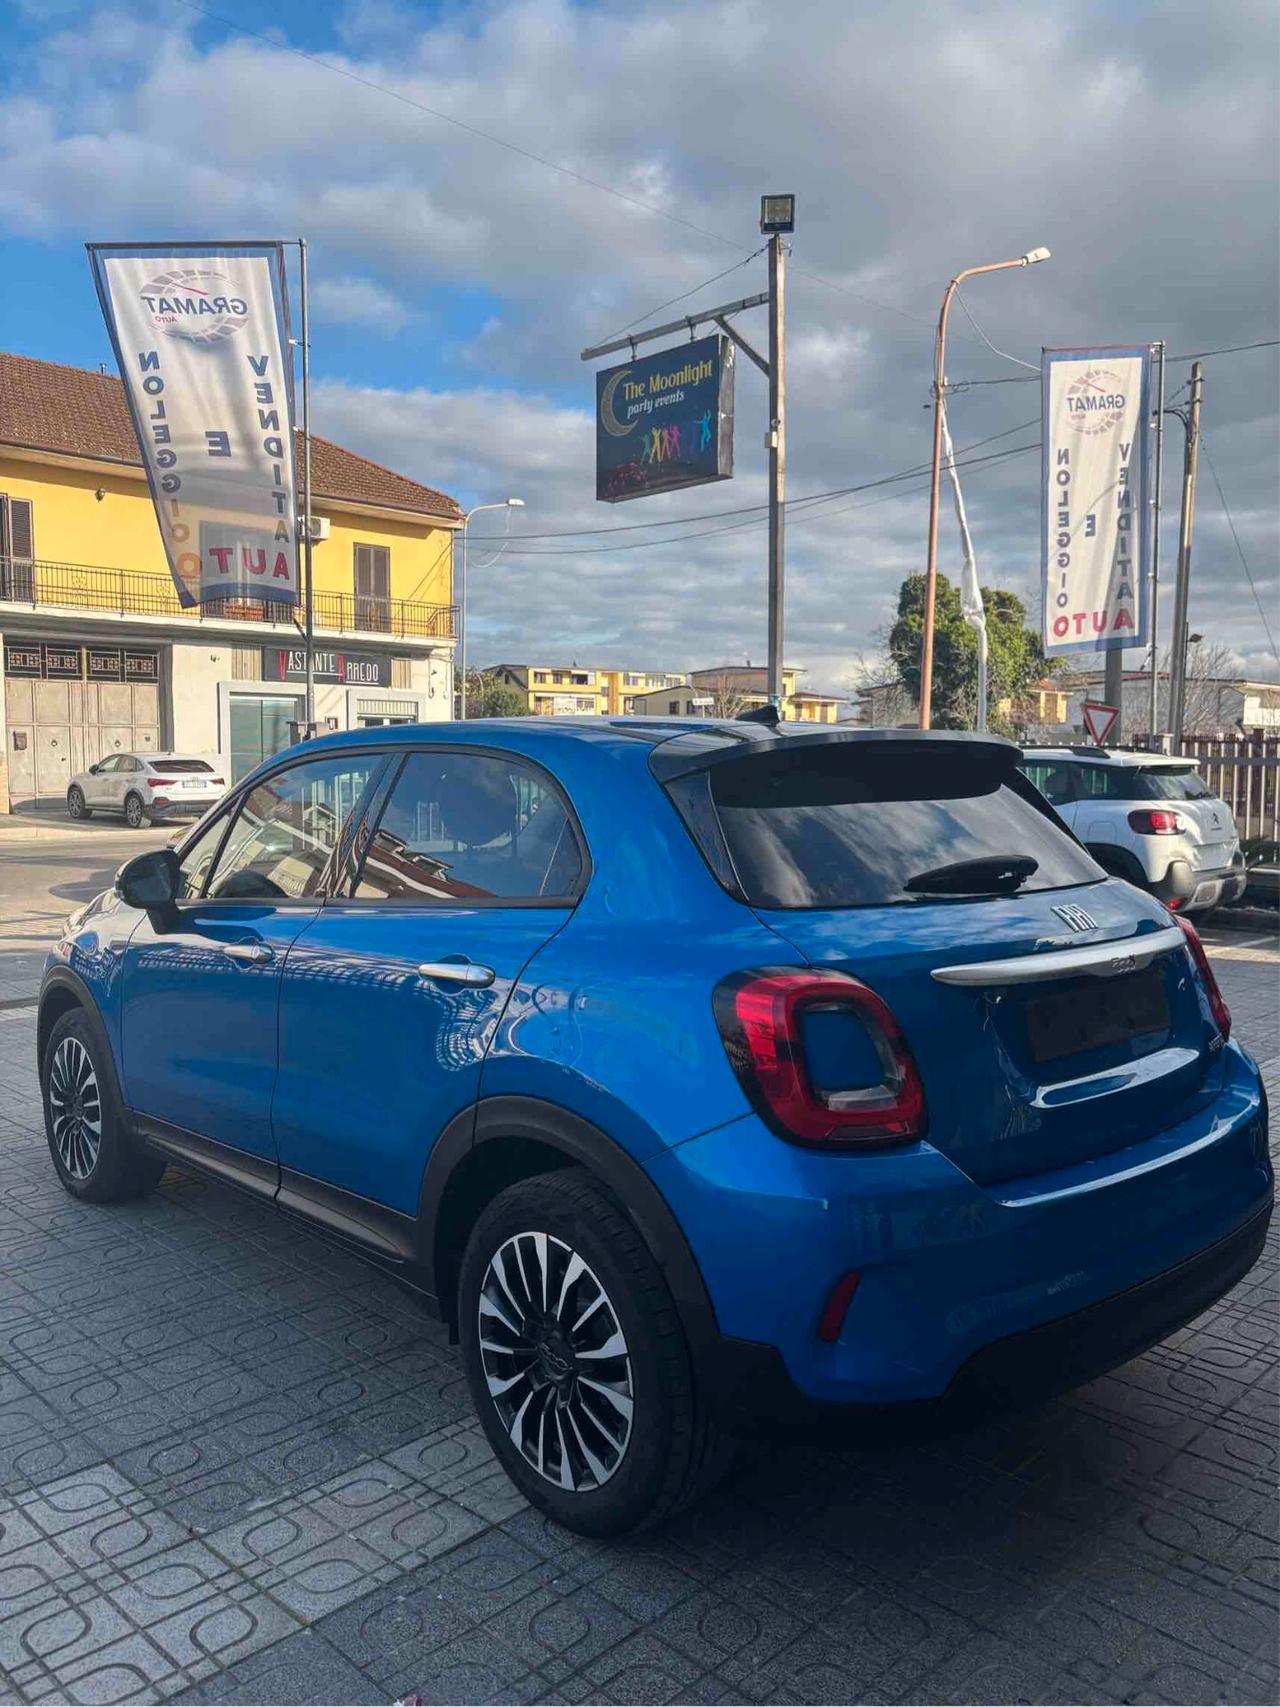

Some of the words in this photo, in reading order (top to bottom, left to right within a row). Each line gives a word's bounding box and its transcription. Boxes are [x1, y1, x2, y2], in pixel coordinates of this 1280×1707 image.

[623, 381, 646, 400] The
[649, 360, 712, 394] Moonlight
[627, 399, 653, 419] party
[655, 390, 685, 407] events
[337, 652, 379, 684] ARREDO
